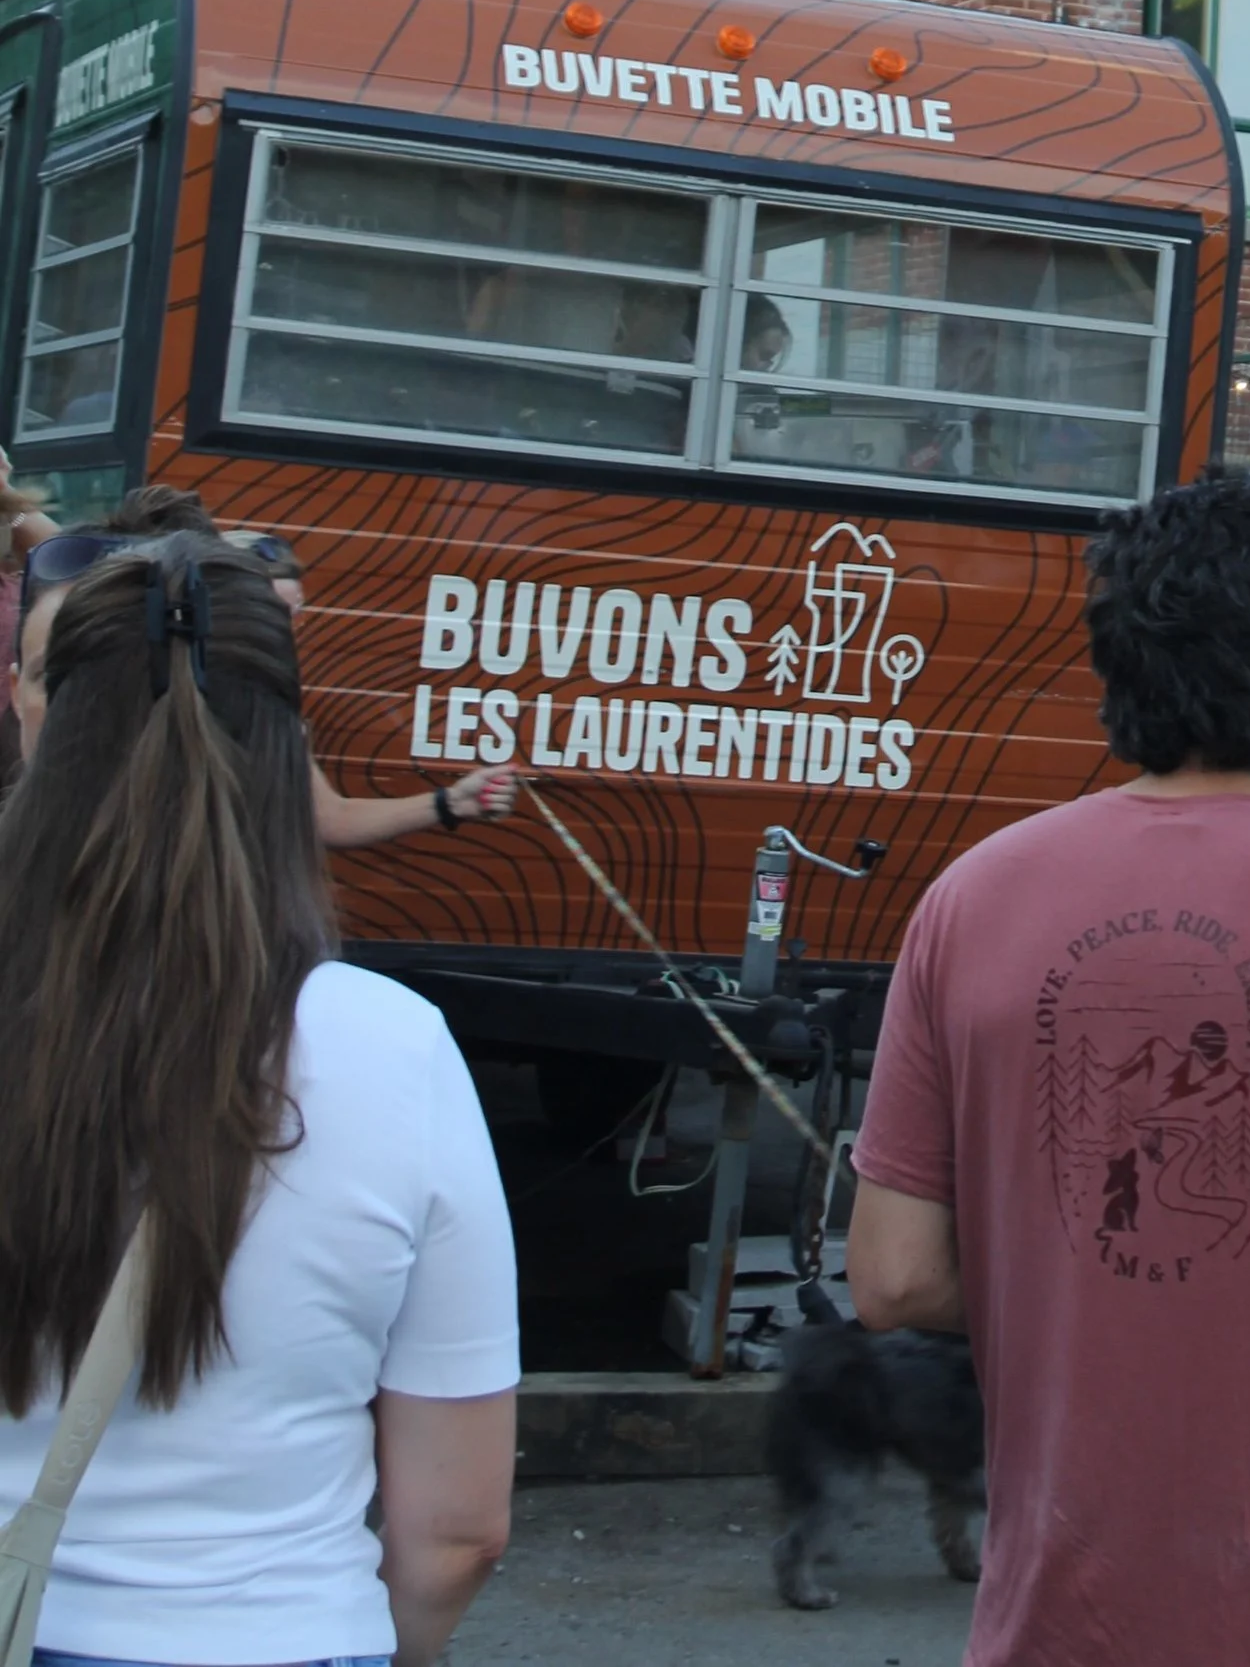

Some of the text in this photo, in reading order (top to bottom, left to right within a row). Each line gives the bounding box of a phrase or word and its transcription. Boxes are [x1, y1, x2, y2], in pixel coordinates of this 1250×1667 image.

[502, 44, 955, 143] BUVETTE MOBILE
[419, 574, 754, 692] BUVONS
[409, 684, 916, 791] LES LAURENTIDES
[1113, 1251, 1193, 1283] M & F
